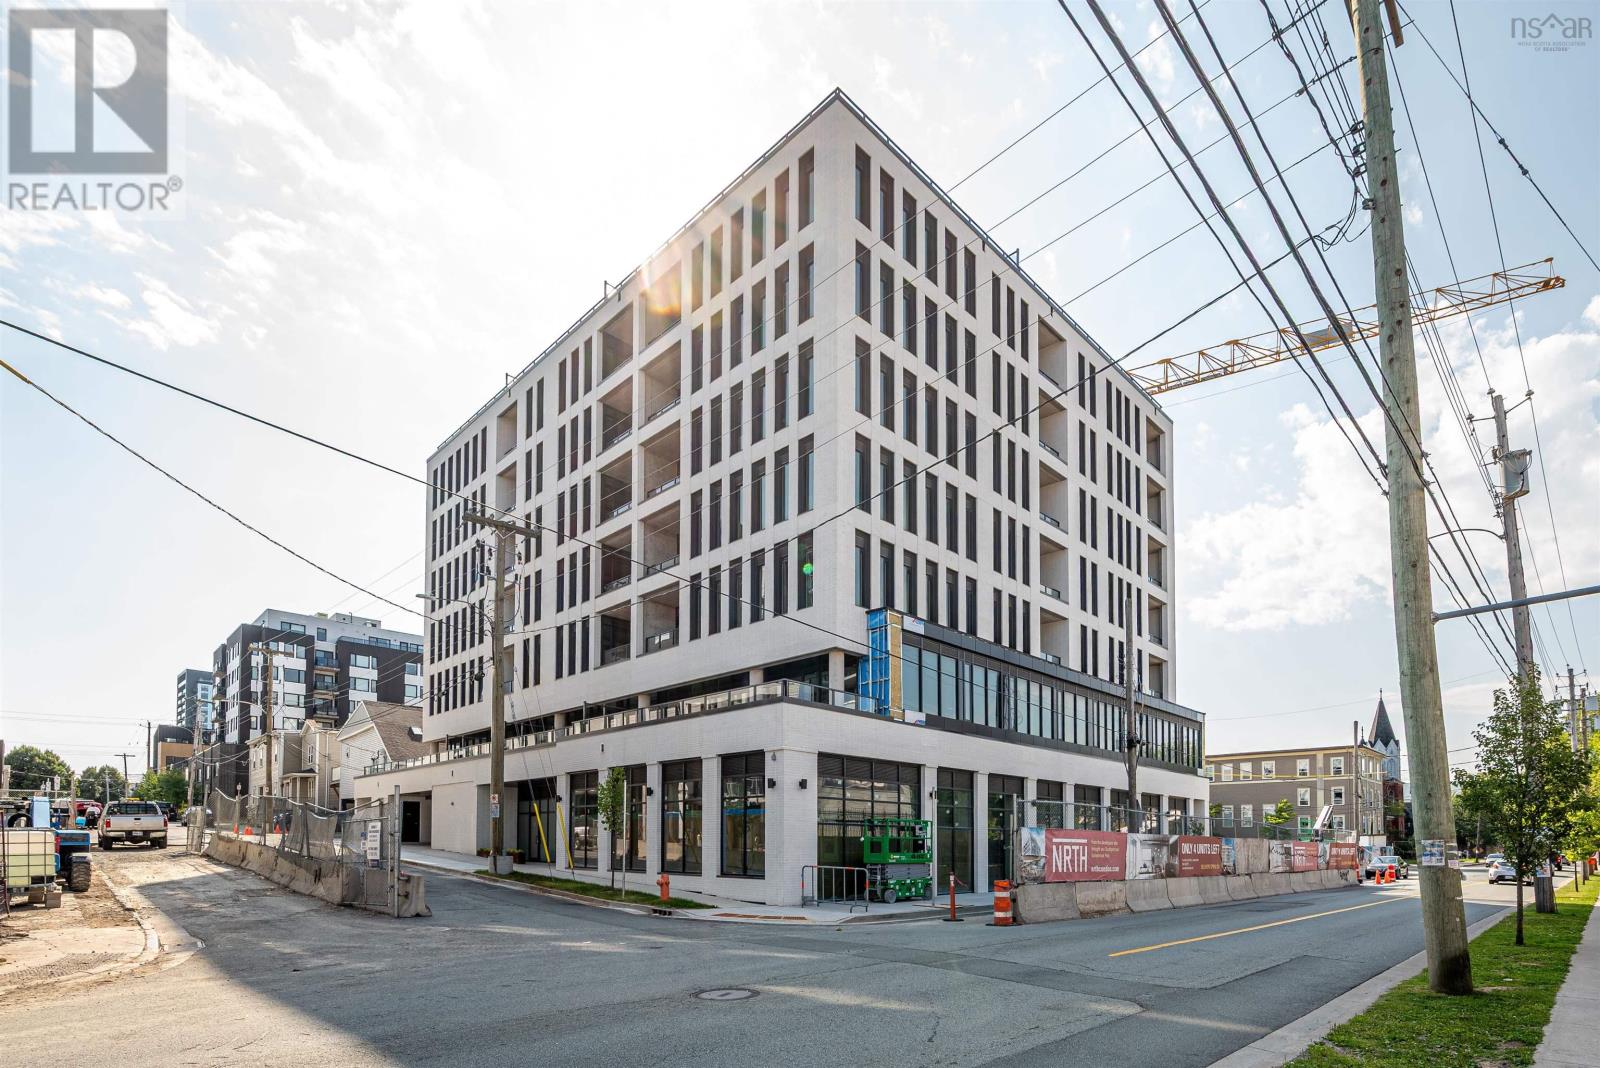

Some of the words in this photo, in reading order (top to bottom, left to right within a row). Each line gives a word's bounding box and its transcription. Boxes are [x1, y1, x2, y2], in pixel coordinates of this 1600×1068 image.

[1052, 845, 1088, 873] NRTH
[1182, 843, 1193, 854] ONLY
[1197, 843, 1210, 854] UNITS
[1211, 844, 1220, 855] LEFT
